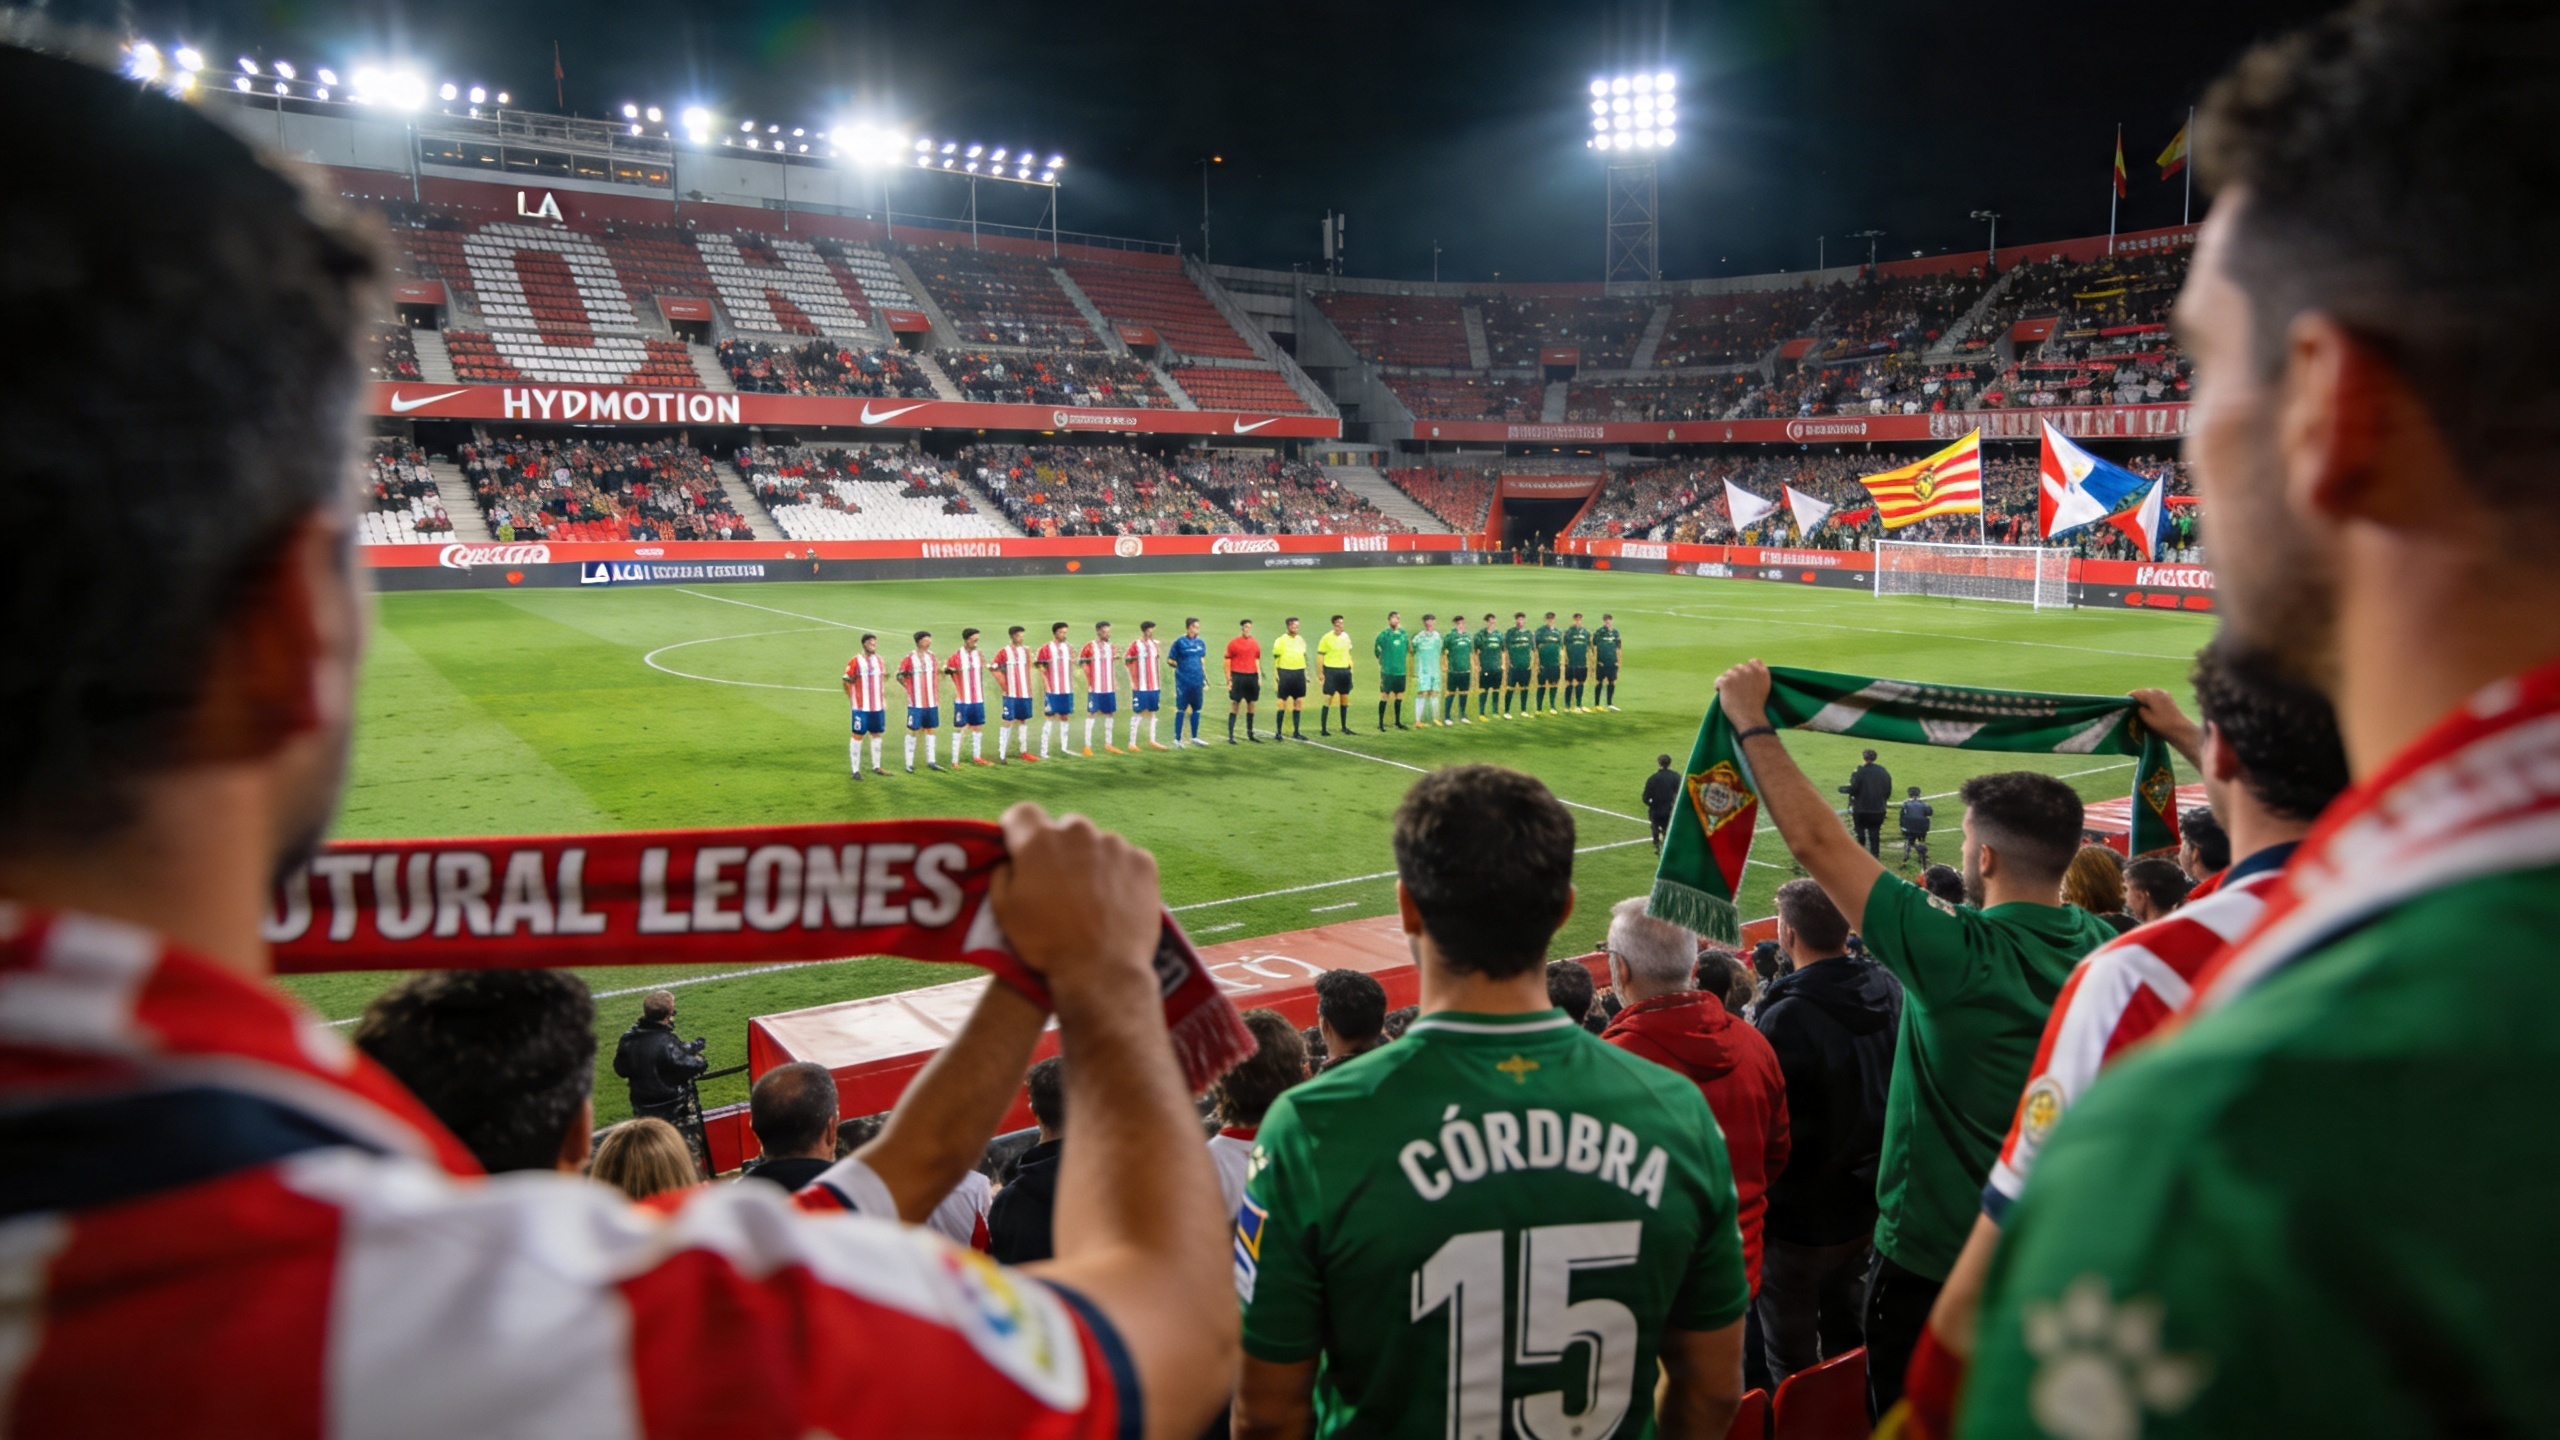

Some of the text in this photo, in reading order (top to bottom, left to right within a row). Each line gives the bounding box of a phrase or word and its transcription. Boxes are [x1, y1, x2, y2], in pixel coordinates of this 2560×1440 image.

[517, 191, 564, 222] LA
[503, 388, 740, 424] HYDMOTION
[638, 841, 969, 935] LEONES
[1400, 1104, 1669, 1210] CÓRDBRA
[1411, 1220, 1643, 1440] 15
